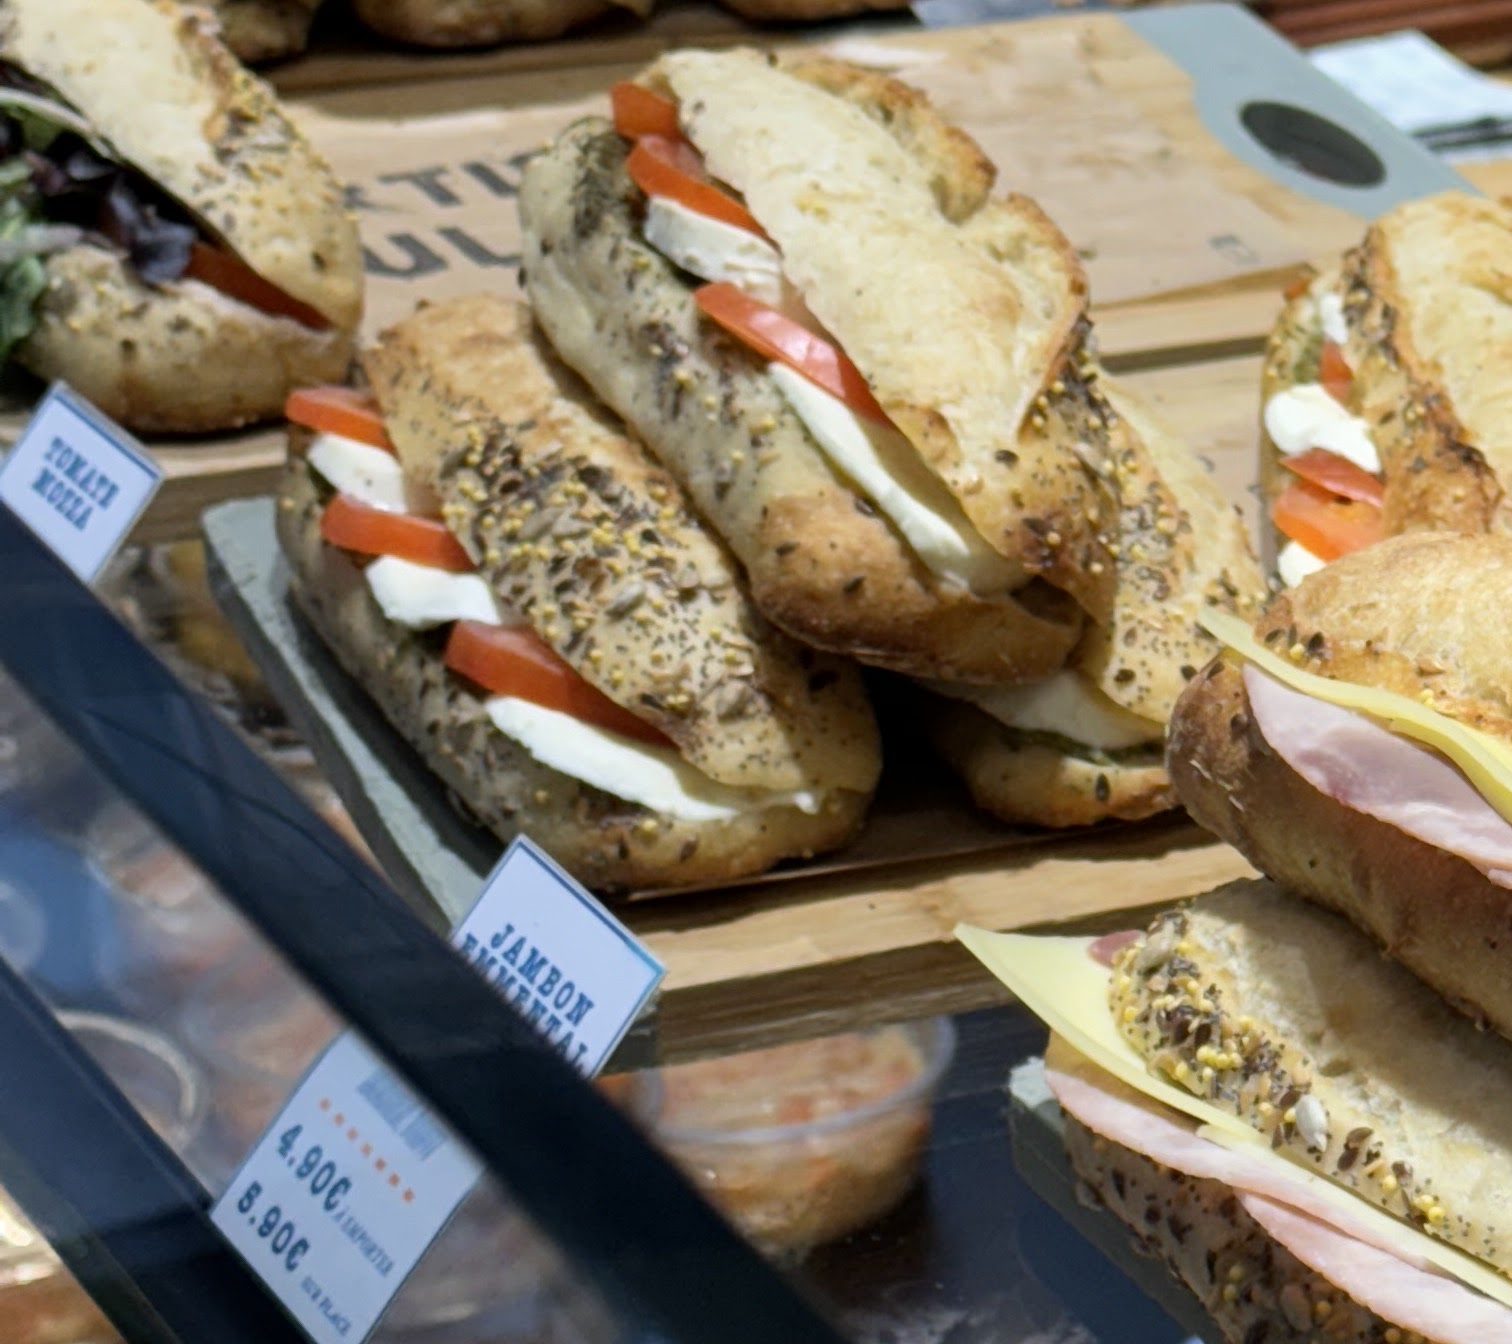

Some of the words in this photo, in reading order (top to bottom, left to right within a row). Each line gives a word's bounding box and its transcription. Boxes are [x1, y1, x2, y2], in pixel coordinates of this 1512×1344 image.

[32, 468, 93, 530] MOZZA
[44, 436, 119, 508] TOMATE
[491, 924, 594, 1026] JAMBON
[278, 1124, 352, 1211] 4.90€
